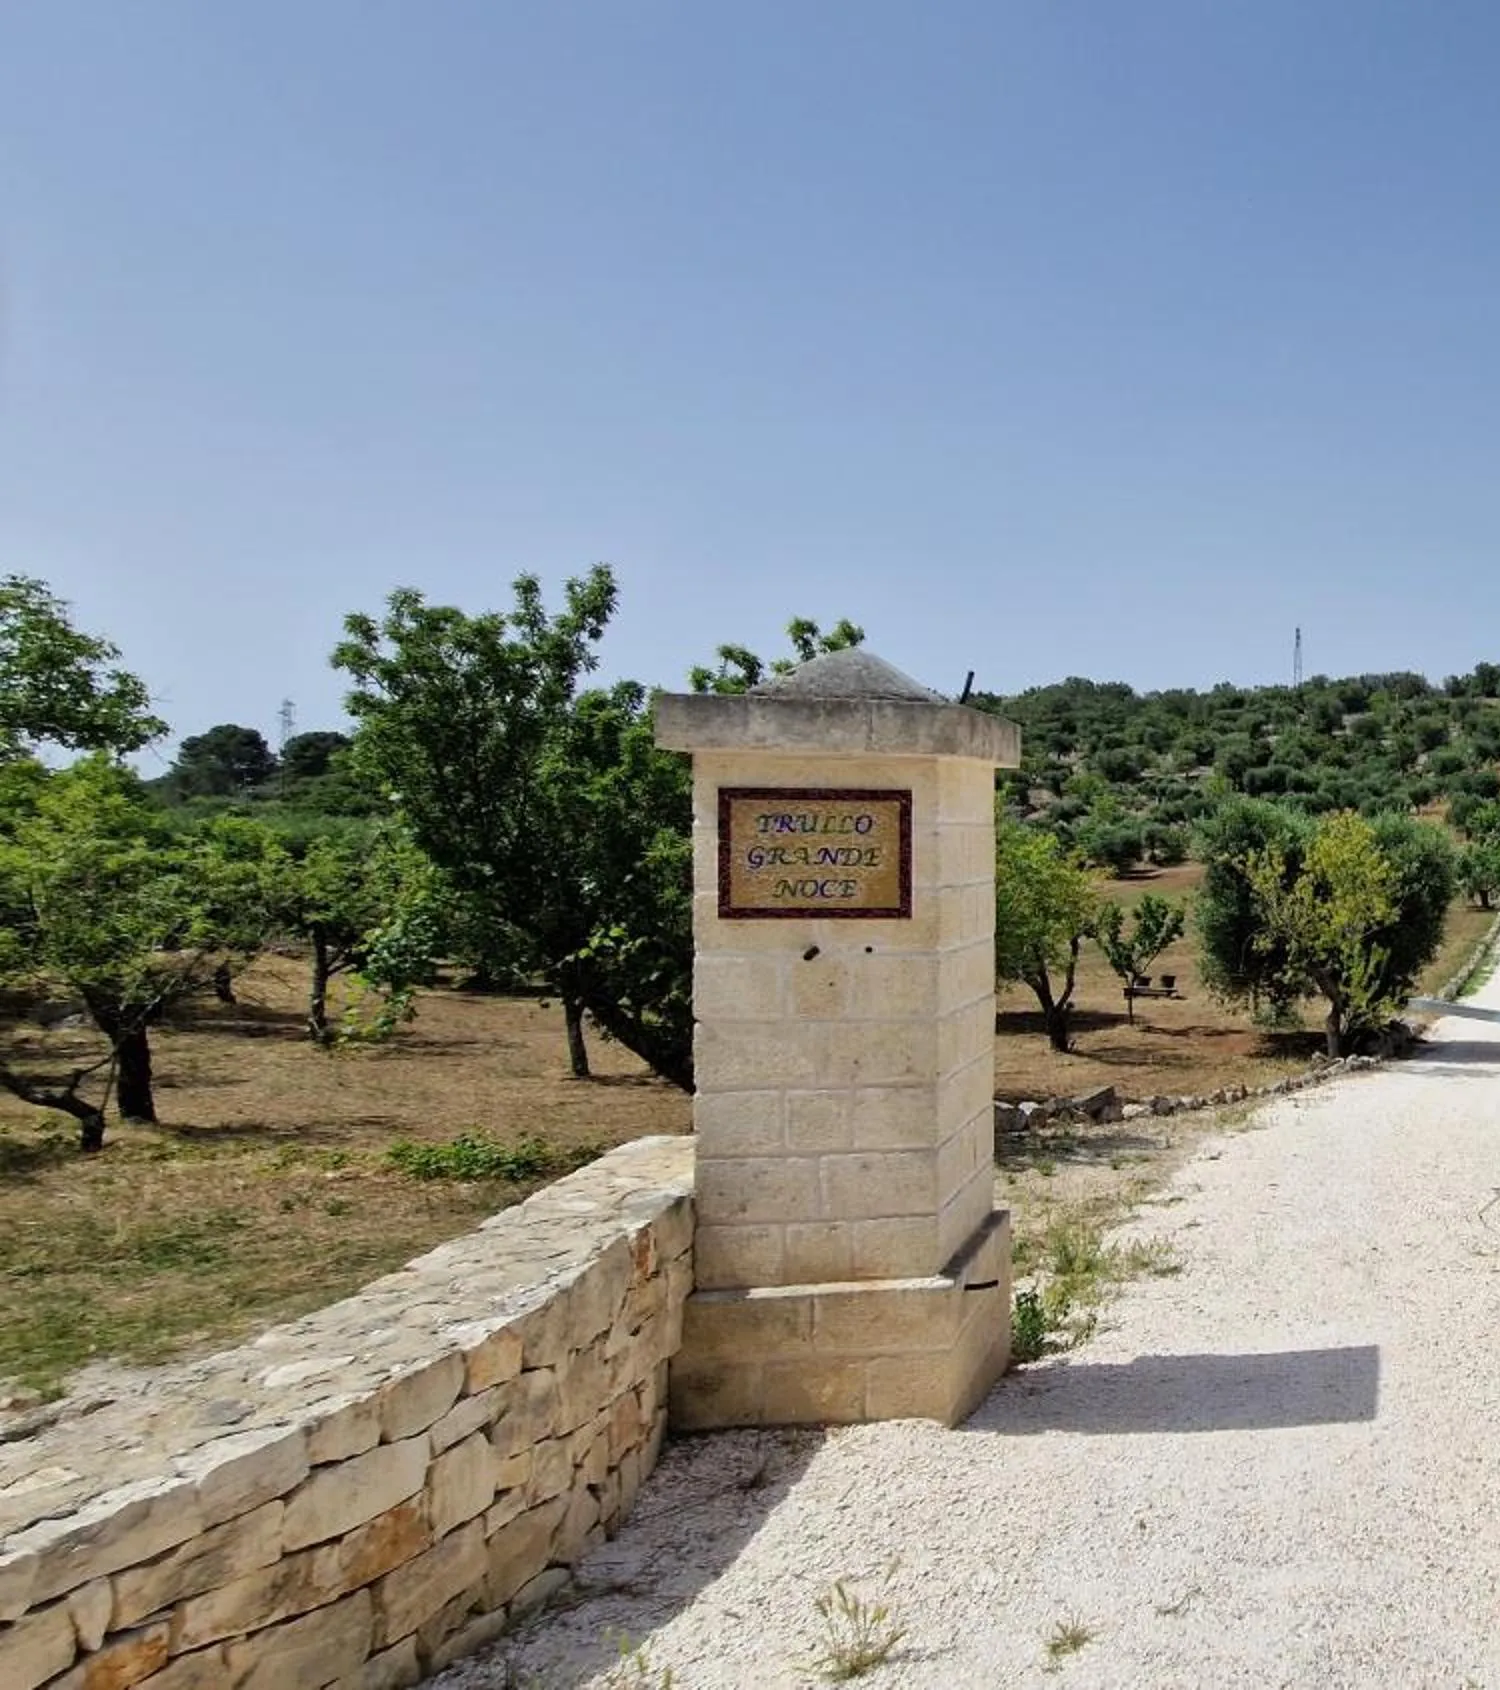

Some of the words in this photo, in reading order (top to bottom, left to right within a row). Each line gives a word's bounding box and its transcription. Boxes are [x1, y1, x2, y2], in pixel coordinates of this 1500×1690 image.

[757, 813, 873, 835] TRULLO
[747, 845, 881, 869] GRANDE
[773, 879, 858, 898] NOCE
